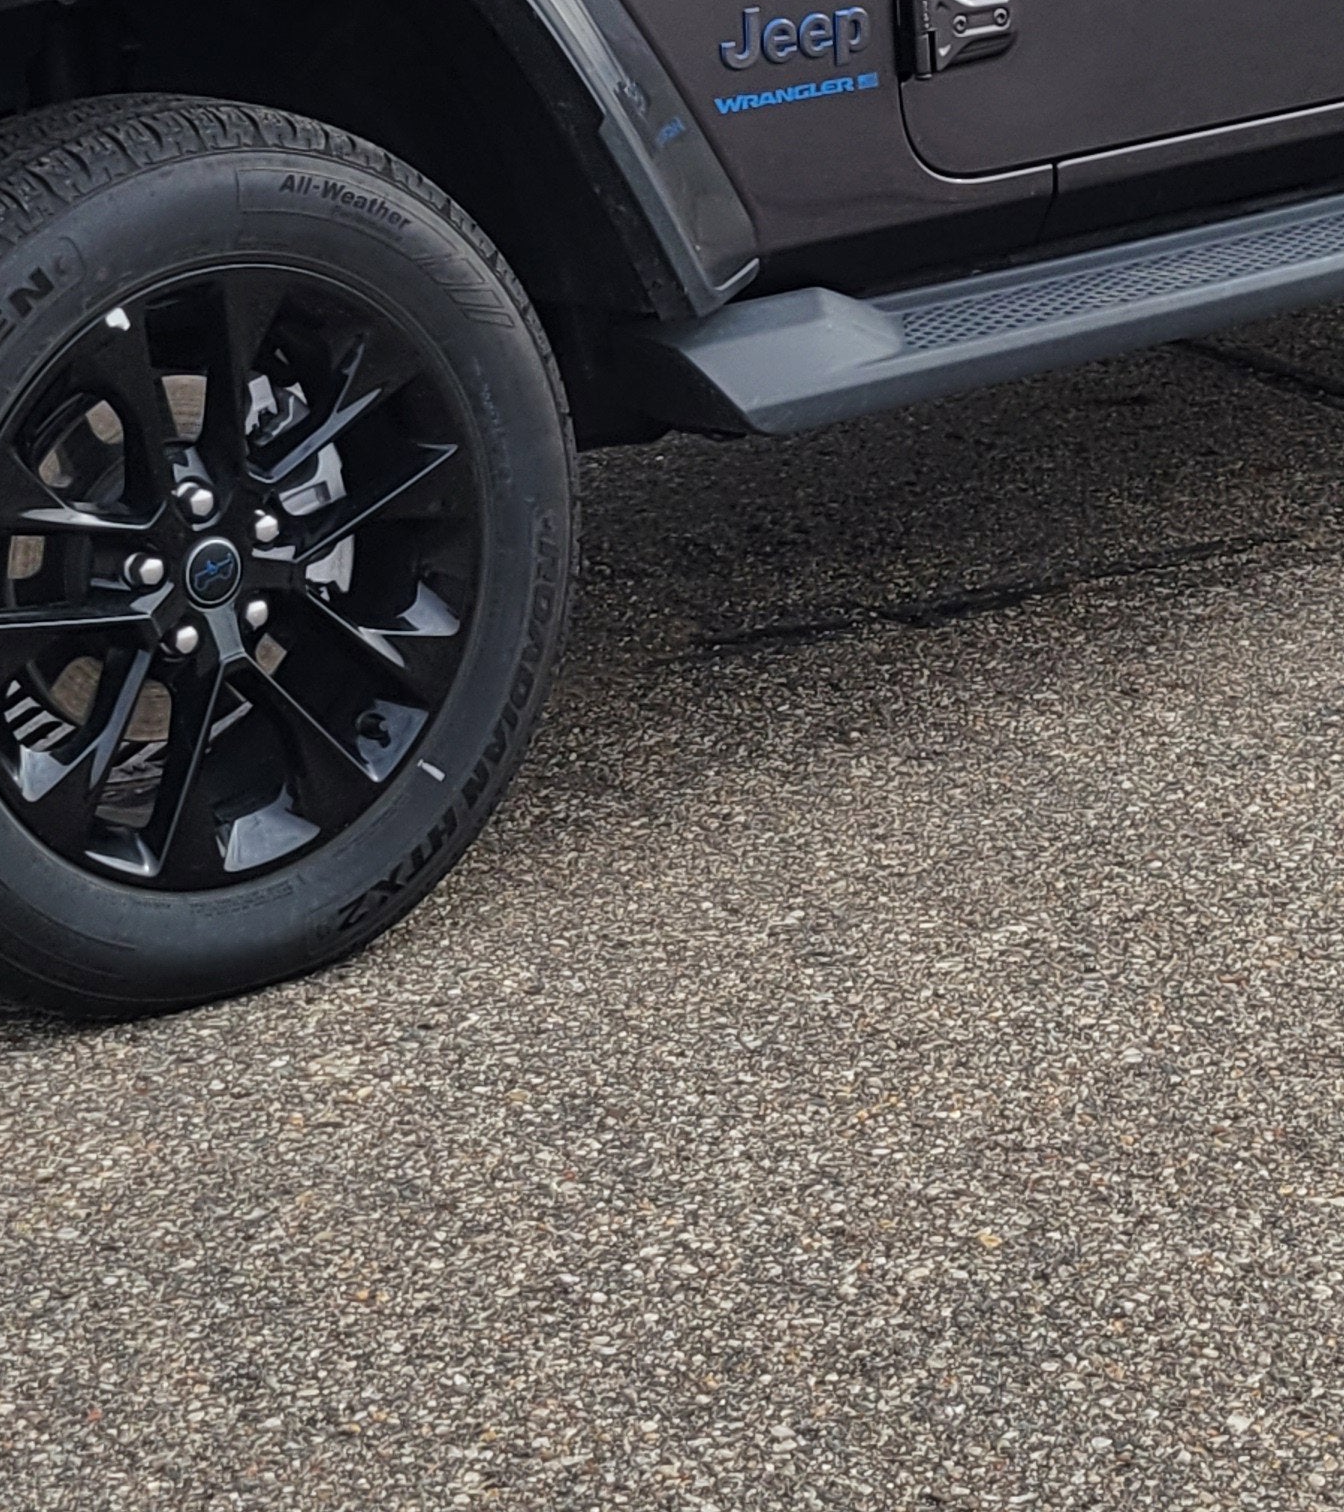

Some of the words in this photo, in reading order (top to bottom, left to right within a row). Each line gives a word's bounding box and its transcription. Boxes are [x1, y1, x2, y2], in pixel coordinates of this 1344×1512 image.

[719, 6, 870, 70] Jeep
[714, 76, 855, 115] WRANGLER
[278, 174, 412, 230] All-Weather
[461, 509, 556, 810] ROADIAN
